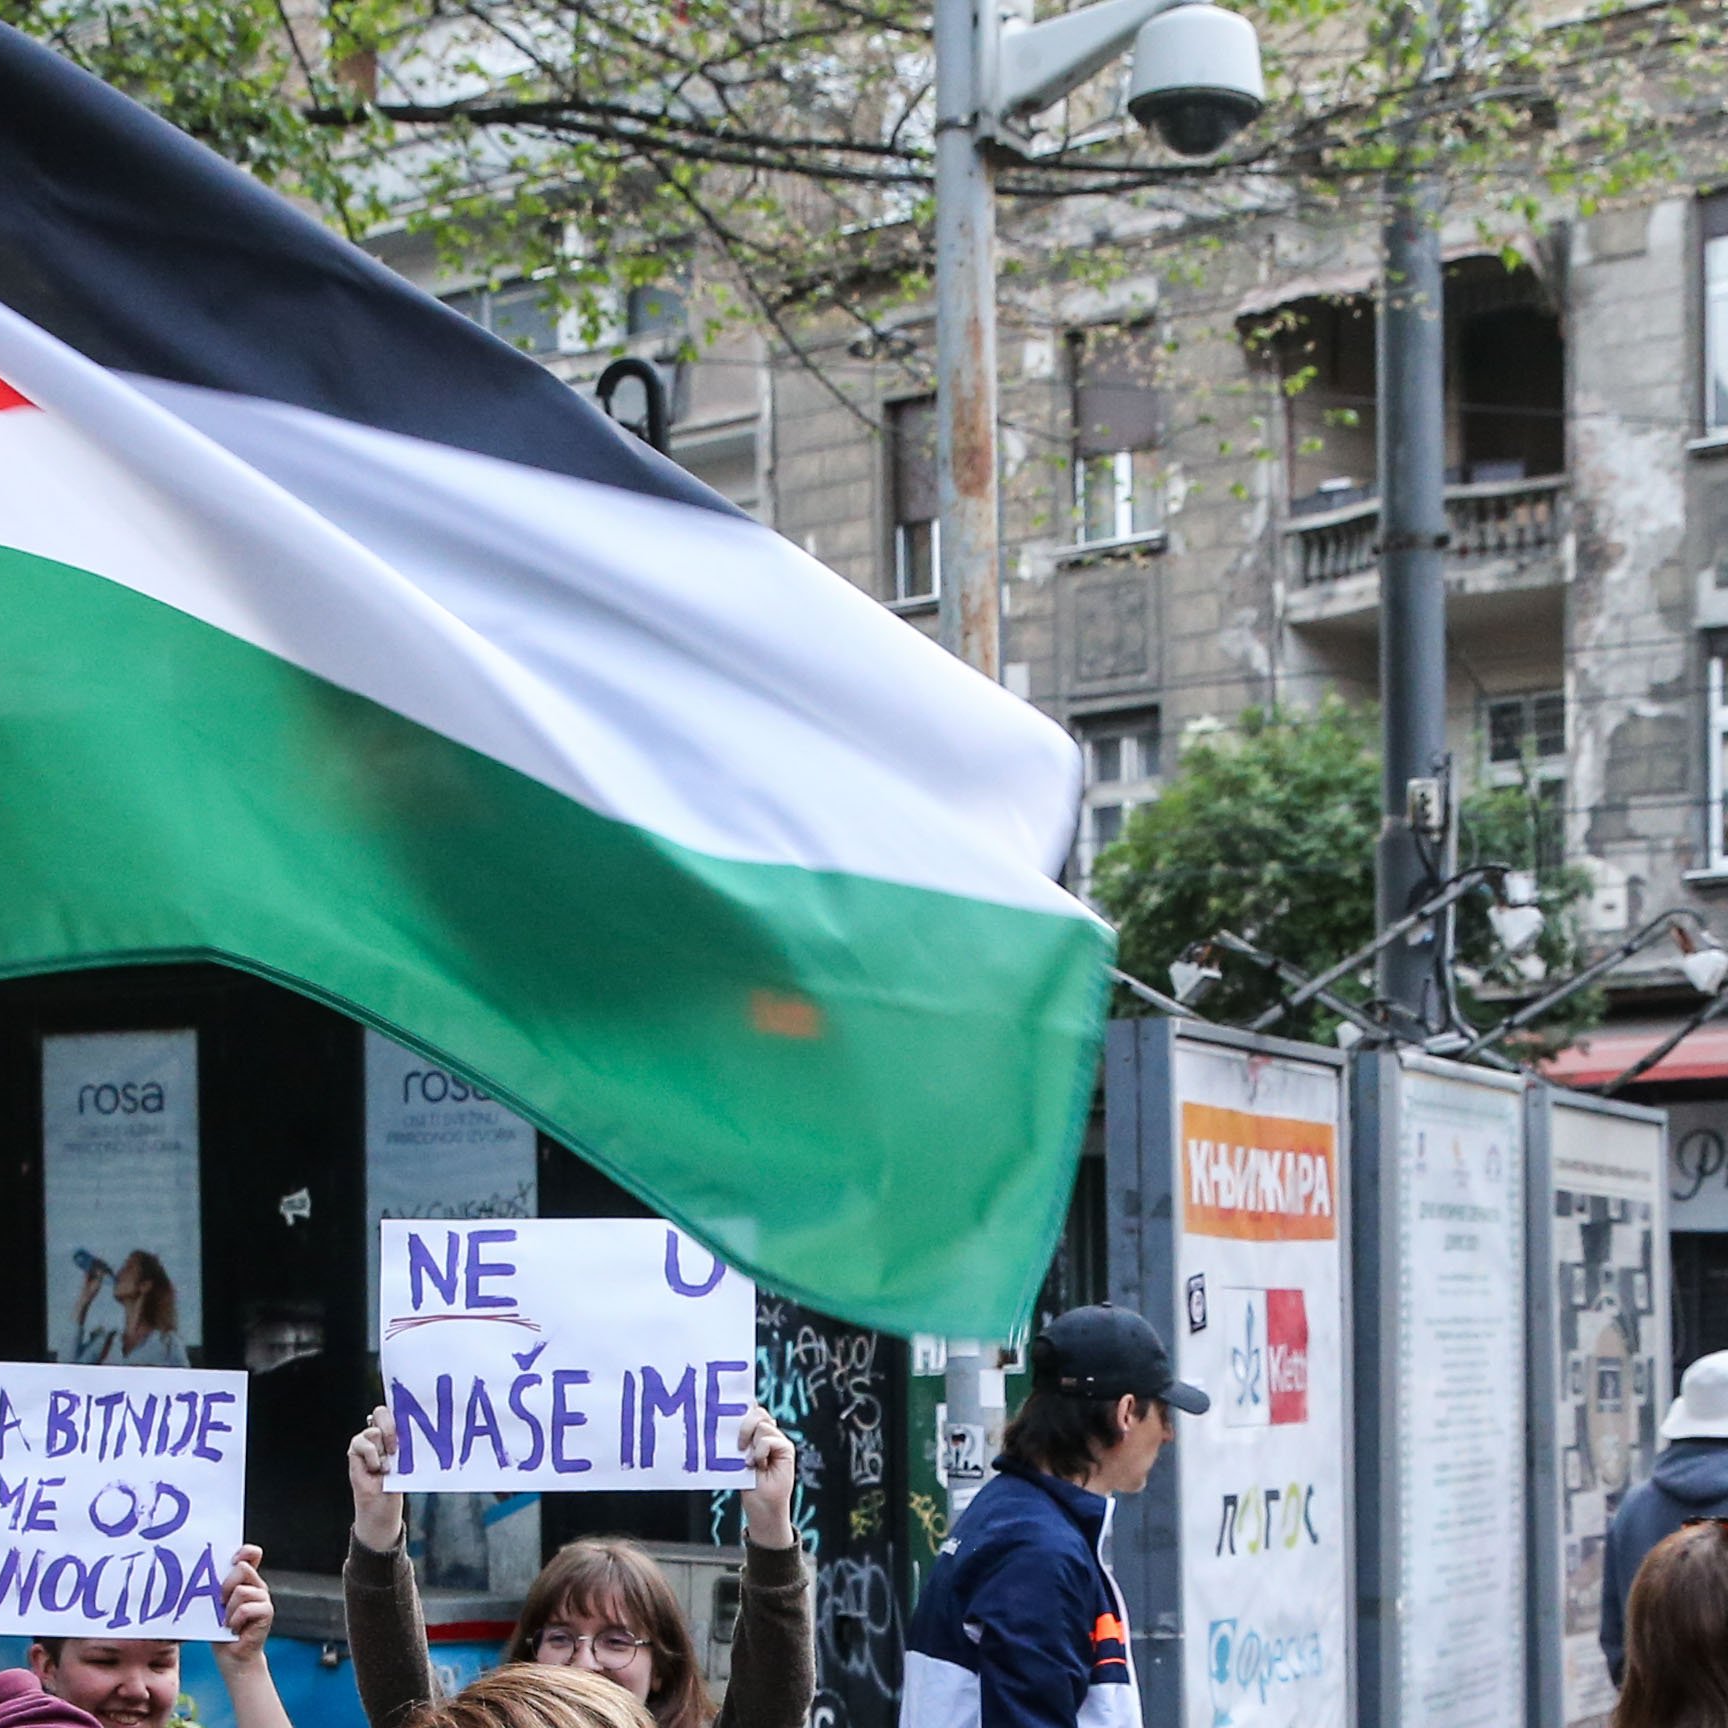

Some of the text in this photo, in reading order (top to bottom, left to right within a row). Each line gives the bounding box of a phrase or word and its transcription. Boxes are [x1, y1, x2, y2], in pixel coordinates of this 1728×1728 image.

[78, 1081, 165, 1116] rosa
[408, 1229, 727, 1311] NE U
[46, 1389, 235, 1463] BITNIJE
[392, 1338, 592, 1475] NAŠE
[620, 1361, 748, 1473] IME
[89, 1478, 191, 1540] OD
